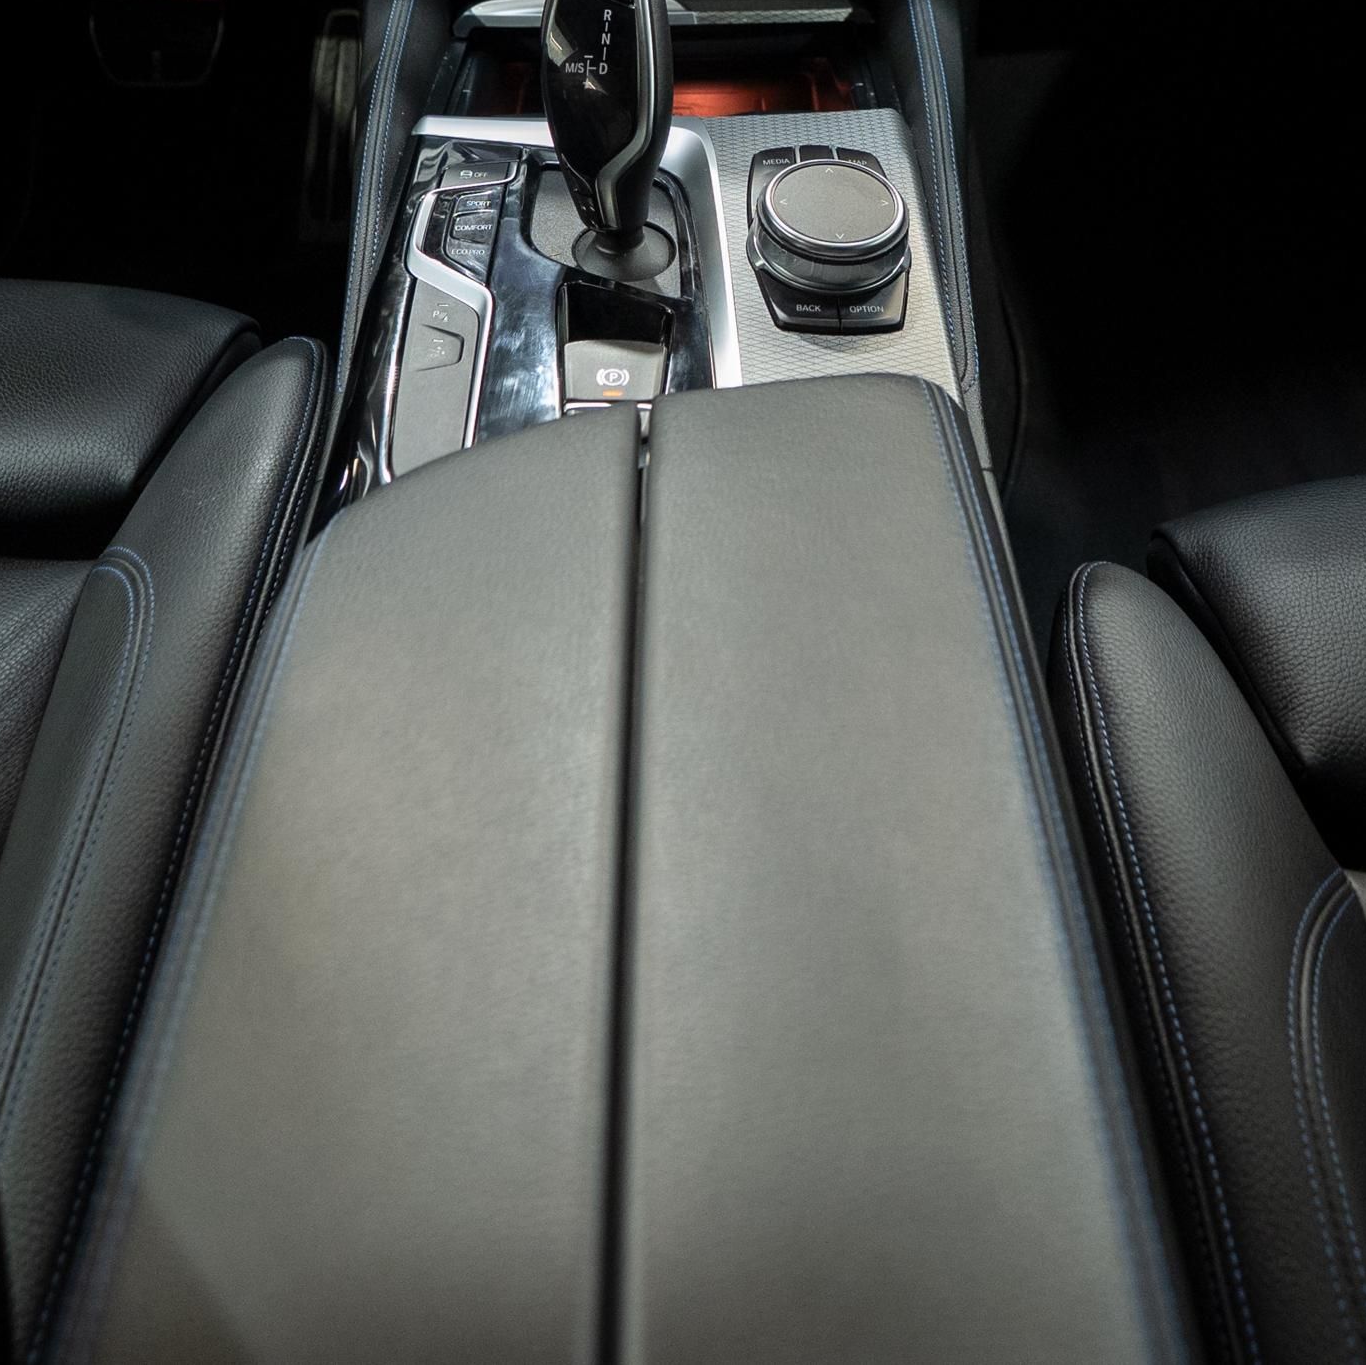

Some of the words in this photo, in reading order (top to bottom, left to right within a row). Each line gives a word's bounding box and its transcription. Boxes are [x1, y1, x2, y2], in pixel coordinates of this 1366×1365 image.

[603, 9, 612, 22] R
[601, 33, 611, 46] N
[565, 62, 585, 74] M/S
[599, 62, 608, 75] D
[762, 157, 791, 166] MEDIA
[455, 224, 492, 232] COMFORT
[795, 303, 822, 313] BACK
[849, 305, 885, 314] OPTION
